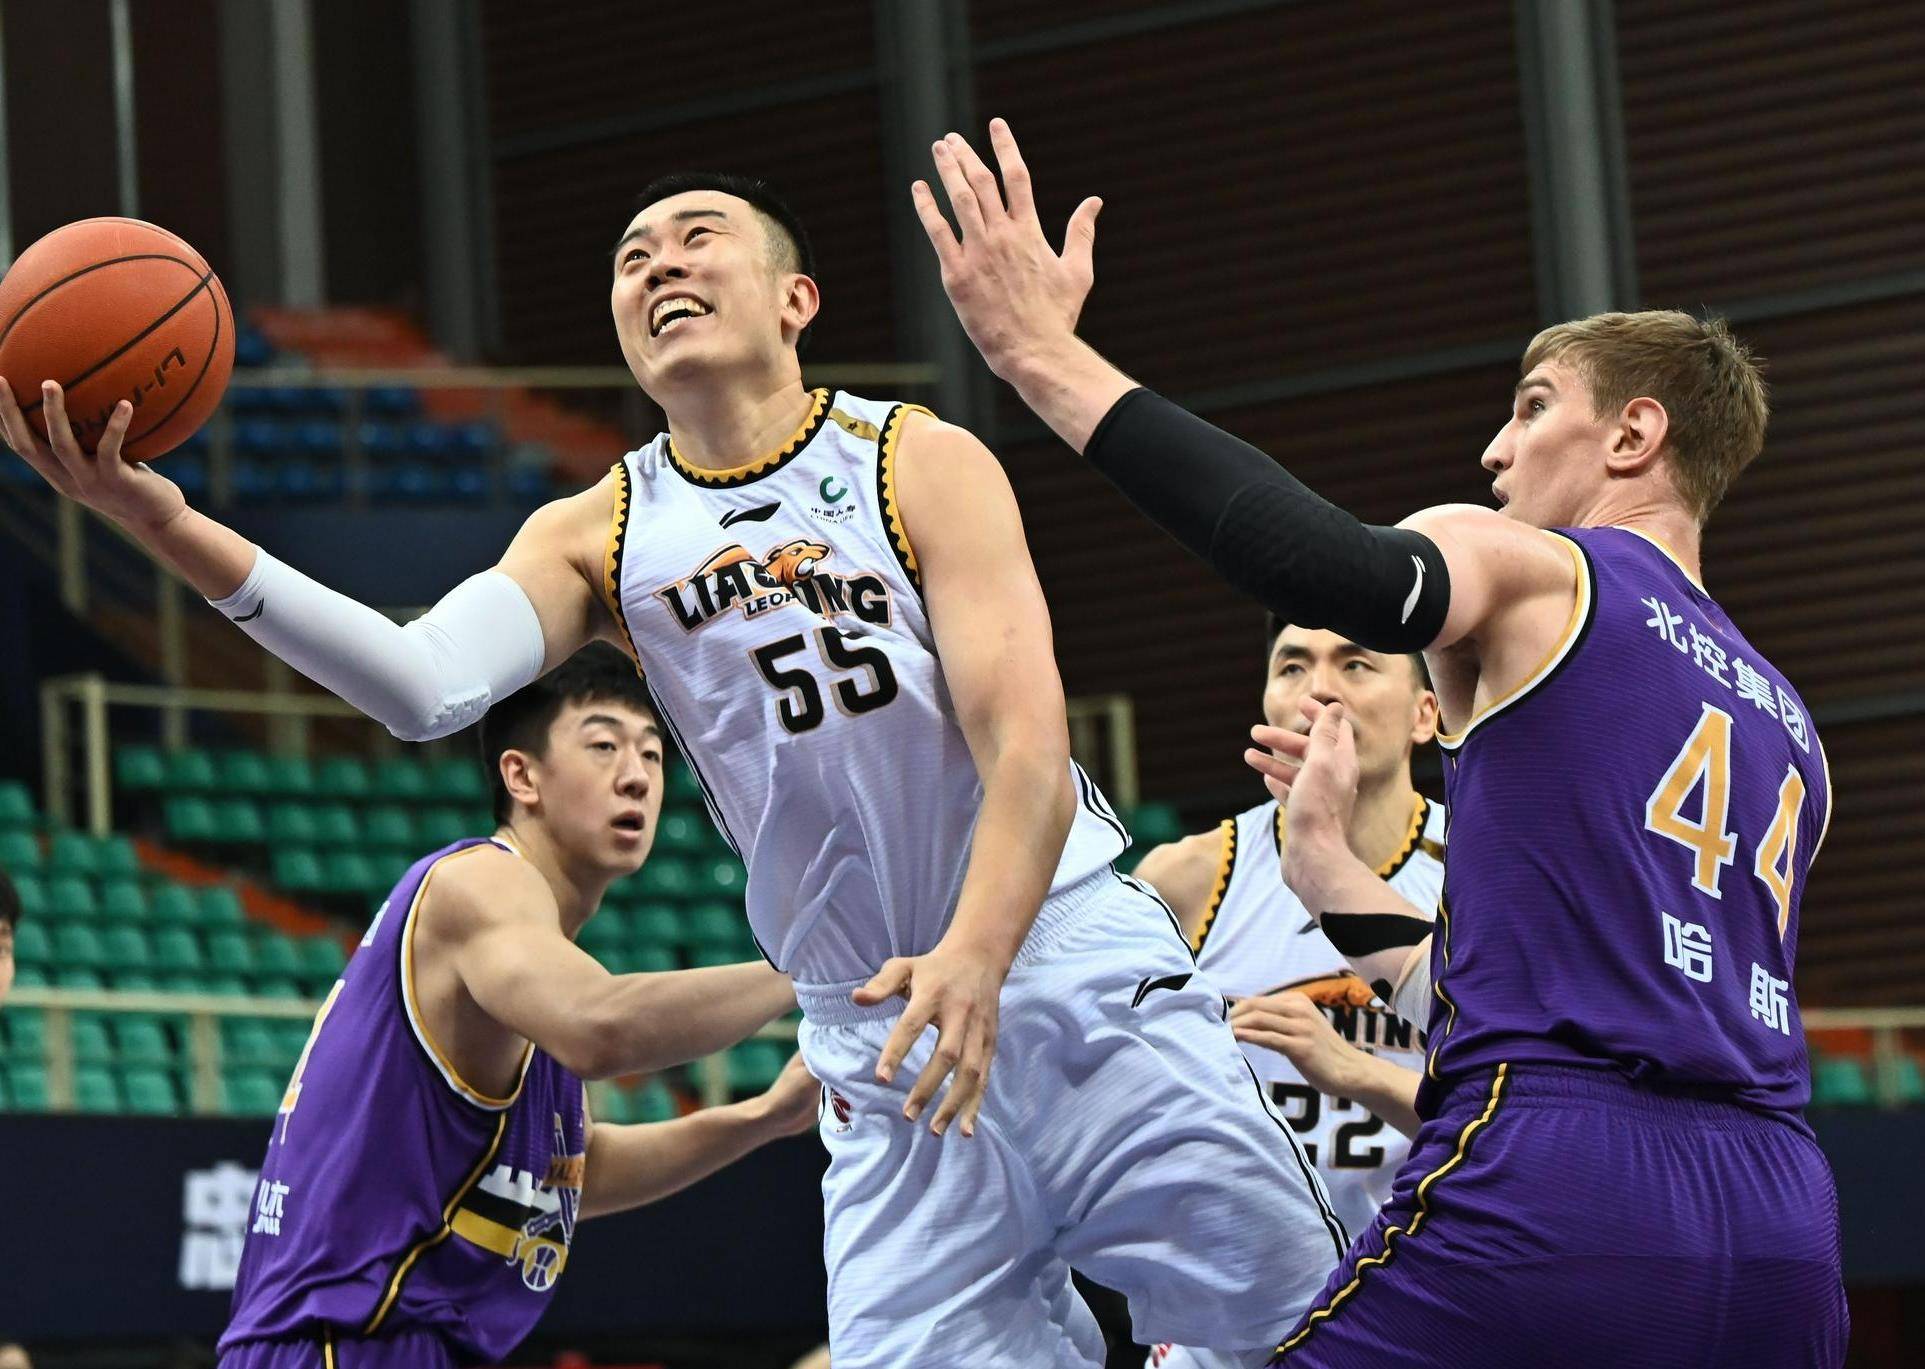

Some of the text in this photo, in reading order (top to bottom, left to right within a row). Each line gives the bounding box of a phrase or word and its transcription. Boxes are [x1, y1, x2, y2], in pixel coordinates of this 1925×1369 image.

[748, 626, 899, 735] 55
[1641, 596, 1811, 754] 北控集团
[1645, 700, 1806, 944] 44
[1661, 910, 1791, 1036] 哈斯
[1267, 1081, 1386, 1170] 22
